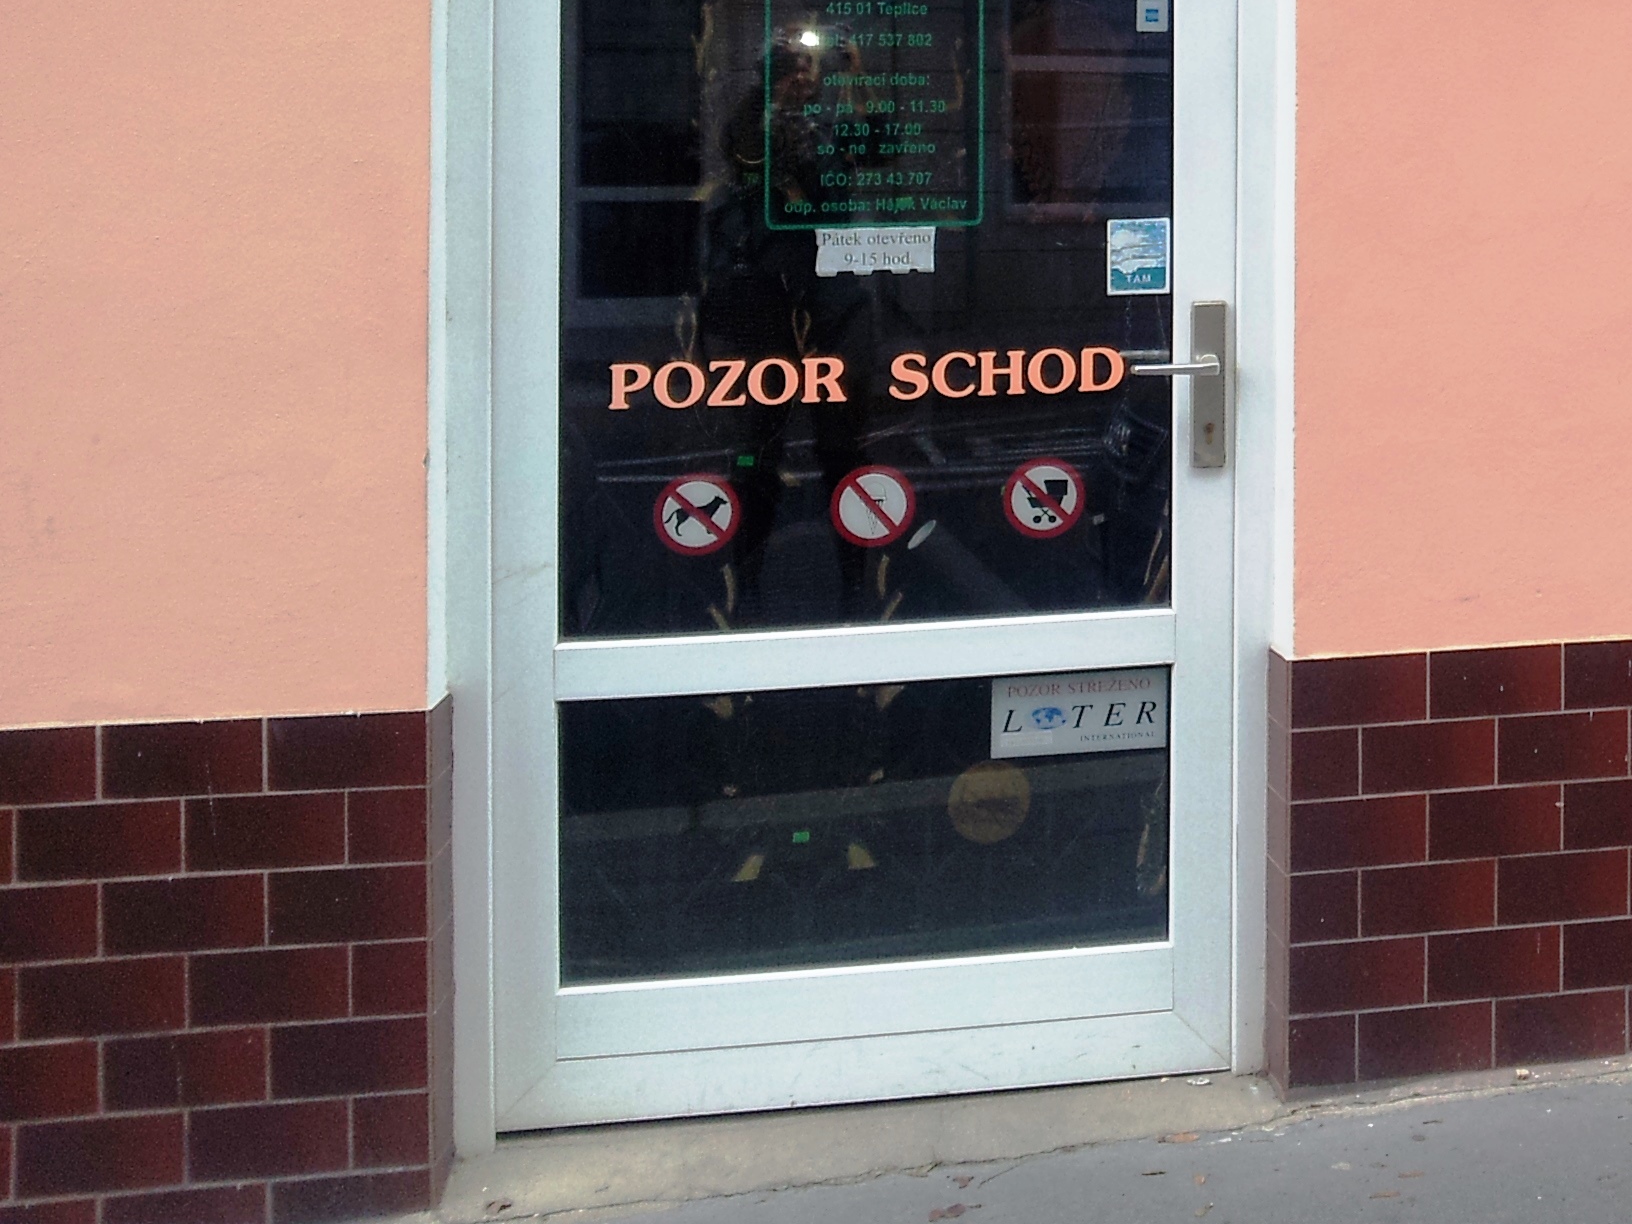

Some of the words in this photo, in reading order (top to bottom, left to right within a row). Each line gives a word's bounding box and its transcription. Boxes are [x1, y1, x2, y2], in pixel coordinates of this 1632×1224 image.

[826, 3, 851, 15] 415
[856, 2, 873, 15] 01
[877, 1, 928, 18] Teplice
[878, 34, 903, 46] 537
[908, 33, 932, 46] 802
[890, 72, 931, 86] doba:
[803, 103, 822, 116] po
[910, 100, 947, 113] 11.30
[834, 123, 870, 137] 12.30
[885, 123, 922, 136] 17.00
[816, 144, 834, 155] so
[850, 144, 866, 154] ne
[879, 141, 936, 154] zavřeno
[857, 172, 882, 186] 273
[886, 172, 902, 185] 43
[920, 196, 968, 211] Václav
[822, 232, 862, 246] Pátek
[866, 232, 932, 245] otevřeno
[844, 253, 878, 266] 9-15
[1126, 274, 1151, 283] TAM
[607, 355, 847, 412] POZOR
[888, 345, 1126, 401] SCHOD
[1007, 683, 1060, 697] POZOR
[1080, 731, 1155, 742] INTERNATIONAL
